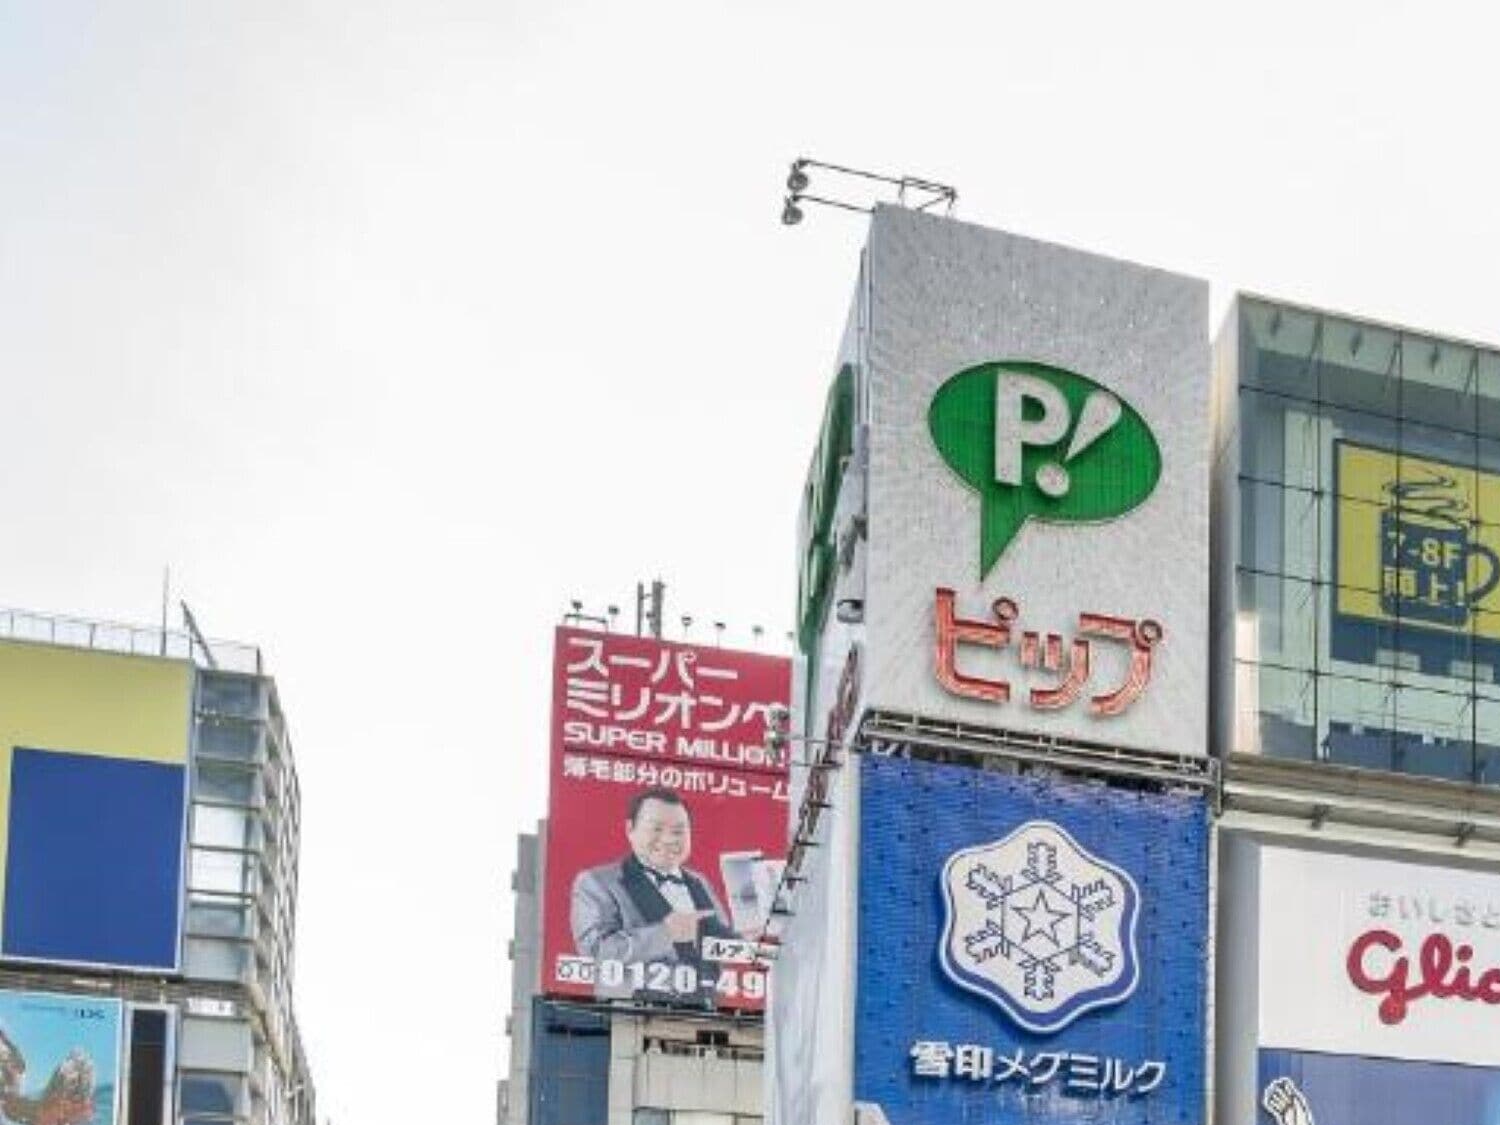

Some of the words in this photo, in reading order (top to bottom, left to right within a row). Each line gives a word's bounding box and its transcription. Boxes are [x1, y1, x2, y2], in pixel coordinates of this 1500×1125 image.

[566, 637, 738, 689] スーパー
[932, 587, 1162, 717] ピップ
[563, 721, 668, 753] SUPER
[909, 1039, 1168, 1094] 雪印メグミルク
